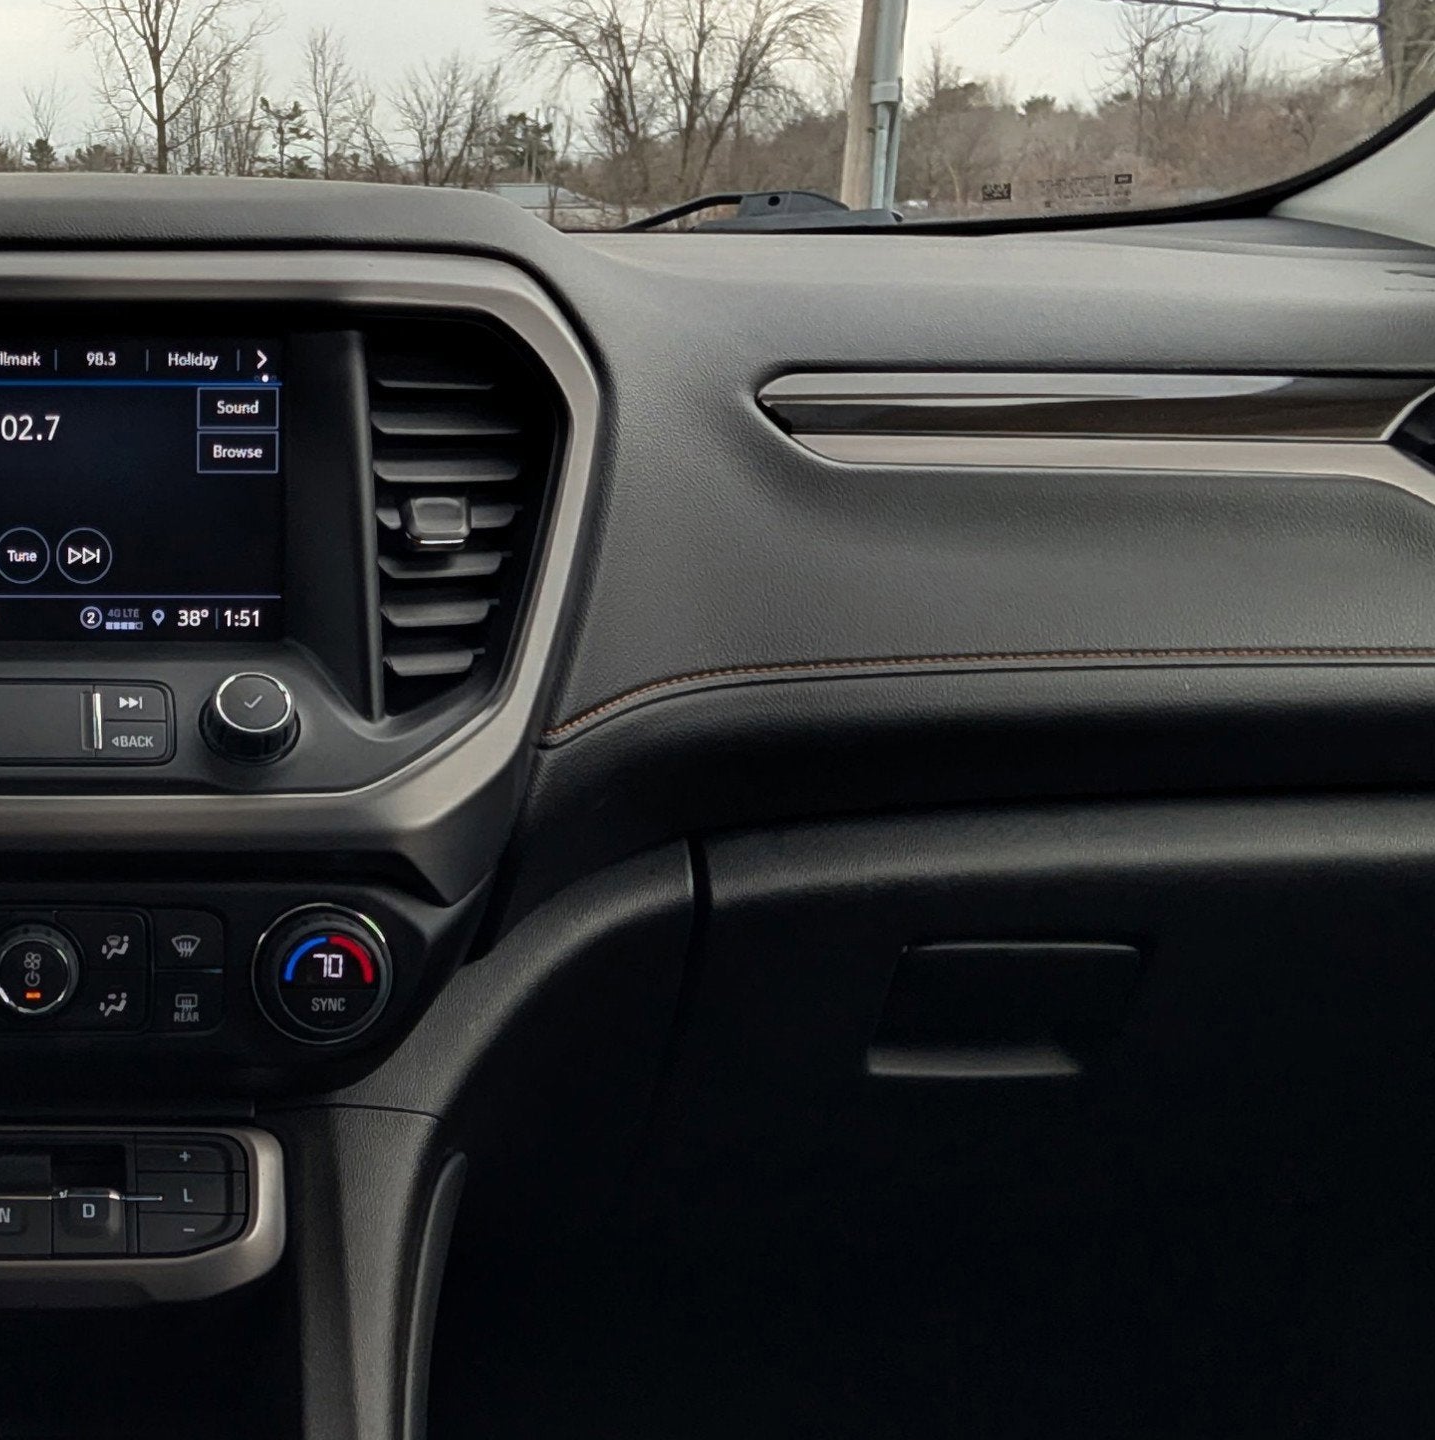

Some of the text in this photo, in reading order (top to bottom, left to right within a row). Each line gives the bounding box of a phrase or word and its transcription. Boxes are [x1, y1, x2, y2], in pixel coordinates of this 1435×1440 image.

[167, 351, 218, 370] Holiday
[216, 400, 260, 415] Sound
[212, 445, 263, 459] Browse
[7, 550, 37, 563] Tune
[123, 609, 139, 618] LTE
[177, 609, 209, 627] 38°
[224, 610, 259, 627] 1:51
[119, 734, 154, 748] BACK
[313, 954, 344, 979] 70
[310, 998, 346, 1011] SYNC
[173, 1011, 200, 1023] REAR
[183, 1189, 192, 1204] L
[82, 1204, 95, 1218] D
